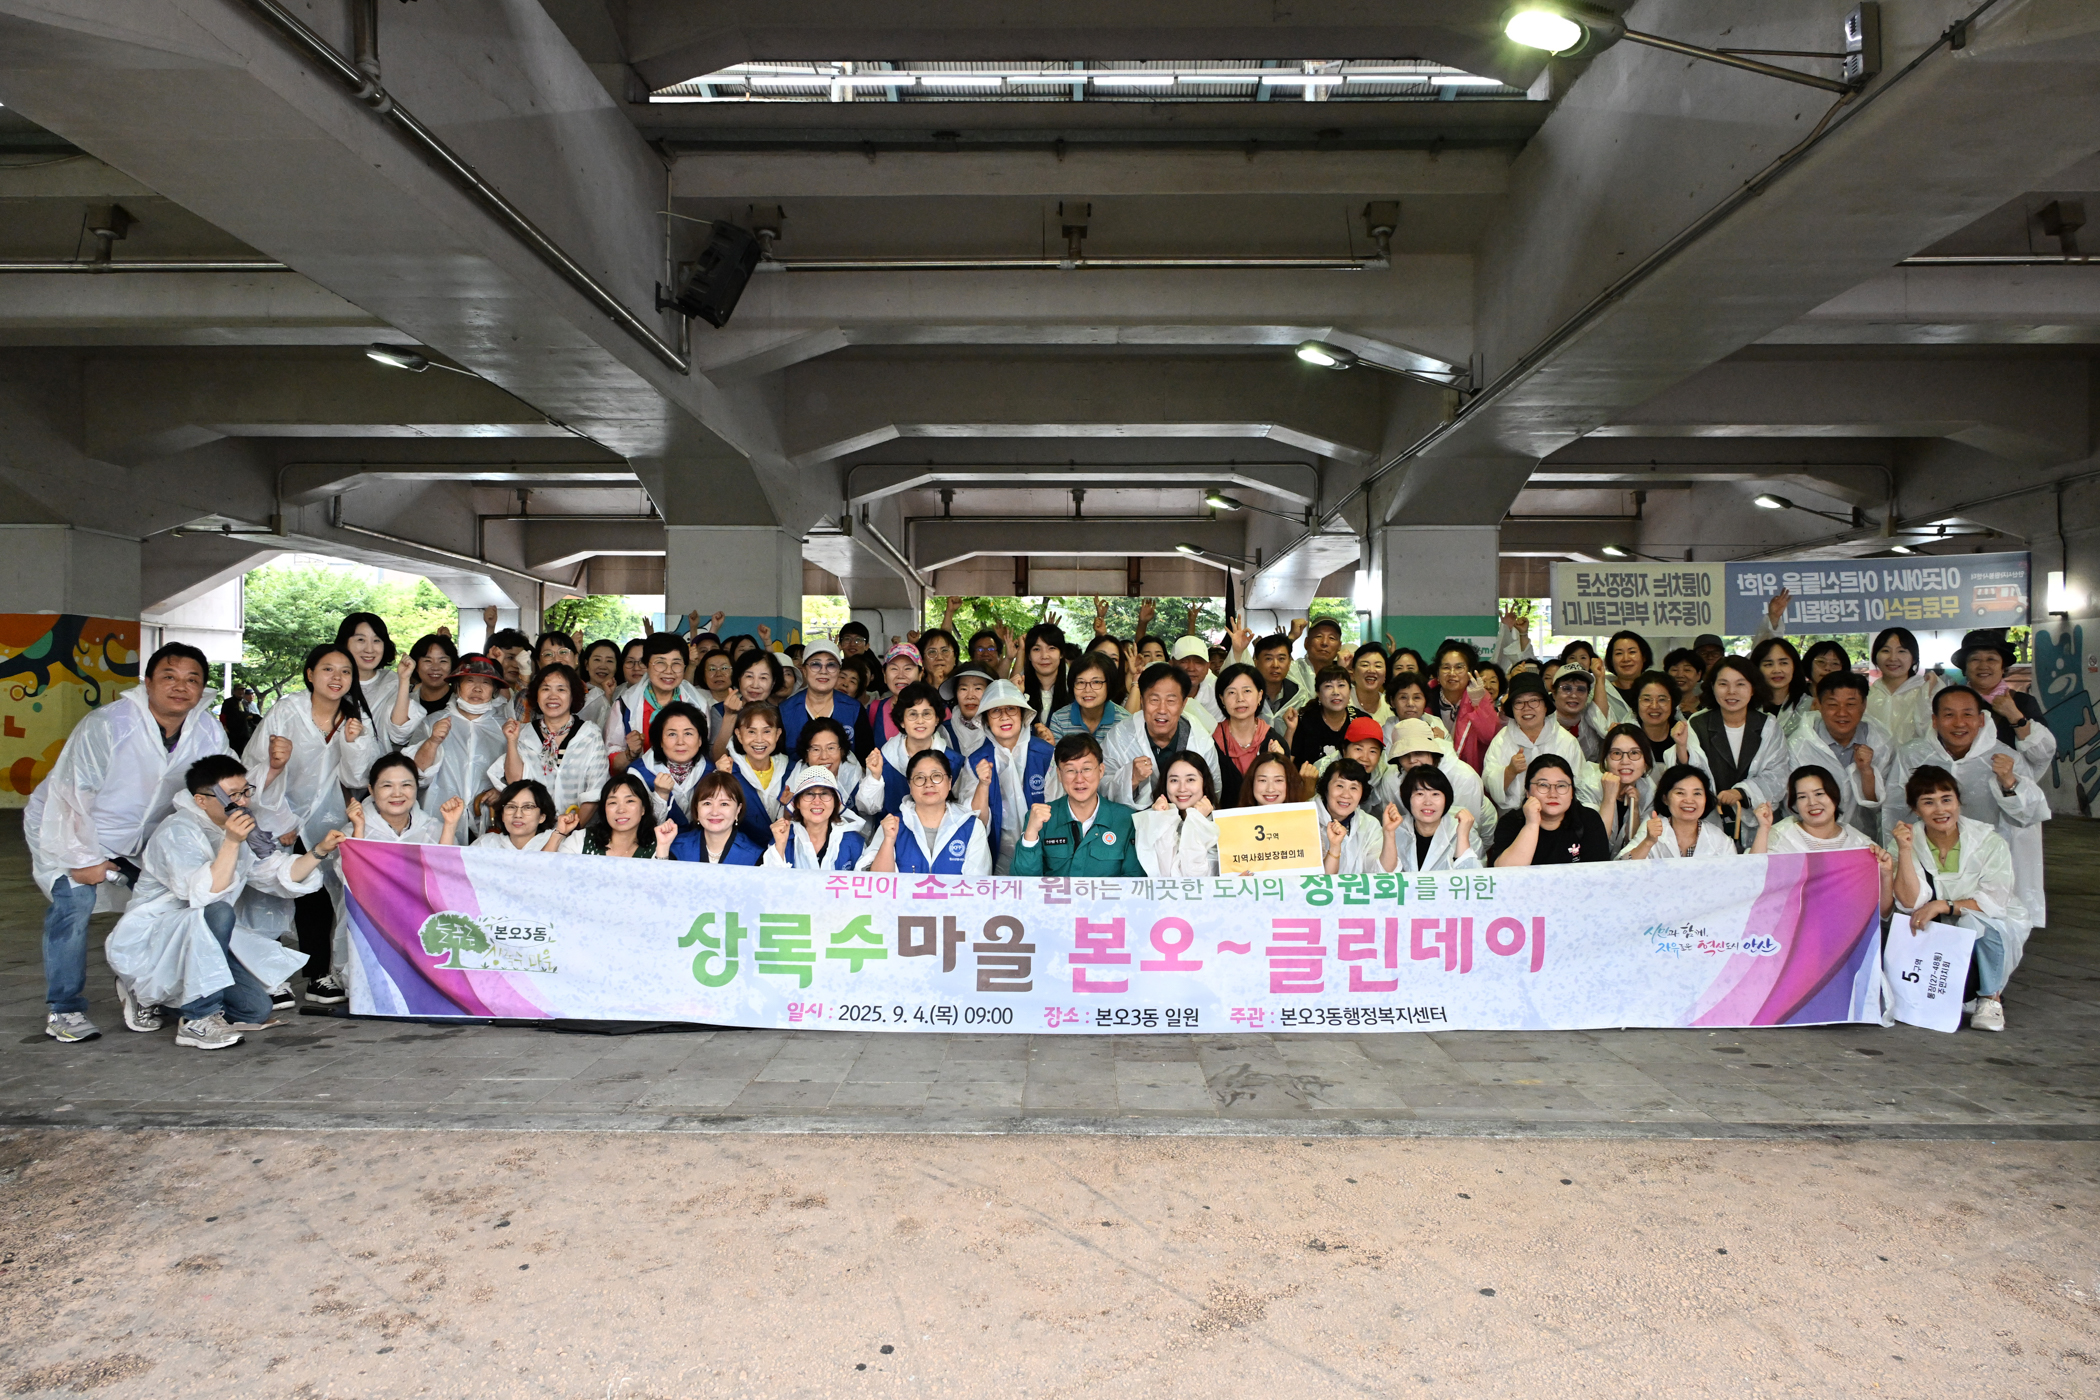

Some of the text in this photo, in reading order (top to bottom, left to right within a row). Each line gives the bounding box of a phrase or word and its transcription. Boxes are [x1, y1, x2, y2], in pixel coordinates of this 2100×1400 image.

[1232, 848, 1305, 864] 지역사회보장협의체
[825, 874, 898, 900] 주민이
[912, 874, 1023, 900] 소소하게
[1038, 876, 1122, 905] 원하는
[1131, 878, 1205, 901] 깨끗한
[1212, 877, 1284, 901] 도시의
[1448, 874, 1497, 901] 위한
[493, 925, 547, 942] 본오3동
[1643, 922, 1680, 944] 시민과
[1655, 937, 1778, 959] 자유로운 혁신도시 안산
[528, 948, 554, 971] 마을
[1937, 960, 1951, 996] 주민자치회
[787, 1002, 823, 1022] 일시
[838, 1004, 887, 1024] 2025.
[893, 1005, 908, 1024] 9.
[913, 1004, 959, 1026] 4.(목)
[964, 1006, 1014, 1025] 09:00
[1043, 1006, 1080, 1029] 장소
[1095, 1007, 1160, 1028] 본오3동
[1165, 1007, 1199, 1028] 일원
[1229, 1007, 1266, 1028] 주관
[1280, 1006, 1448, 1027] 본오3동행정복지센터
